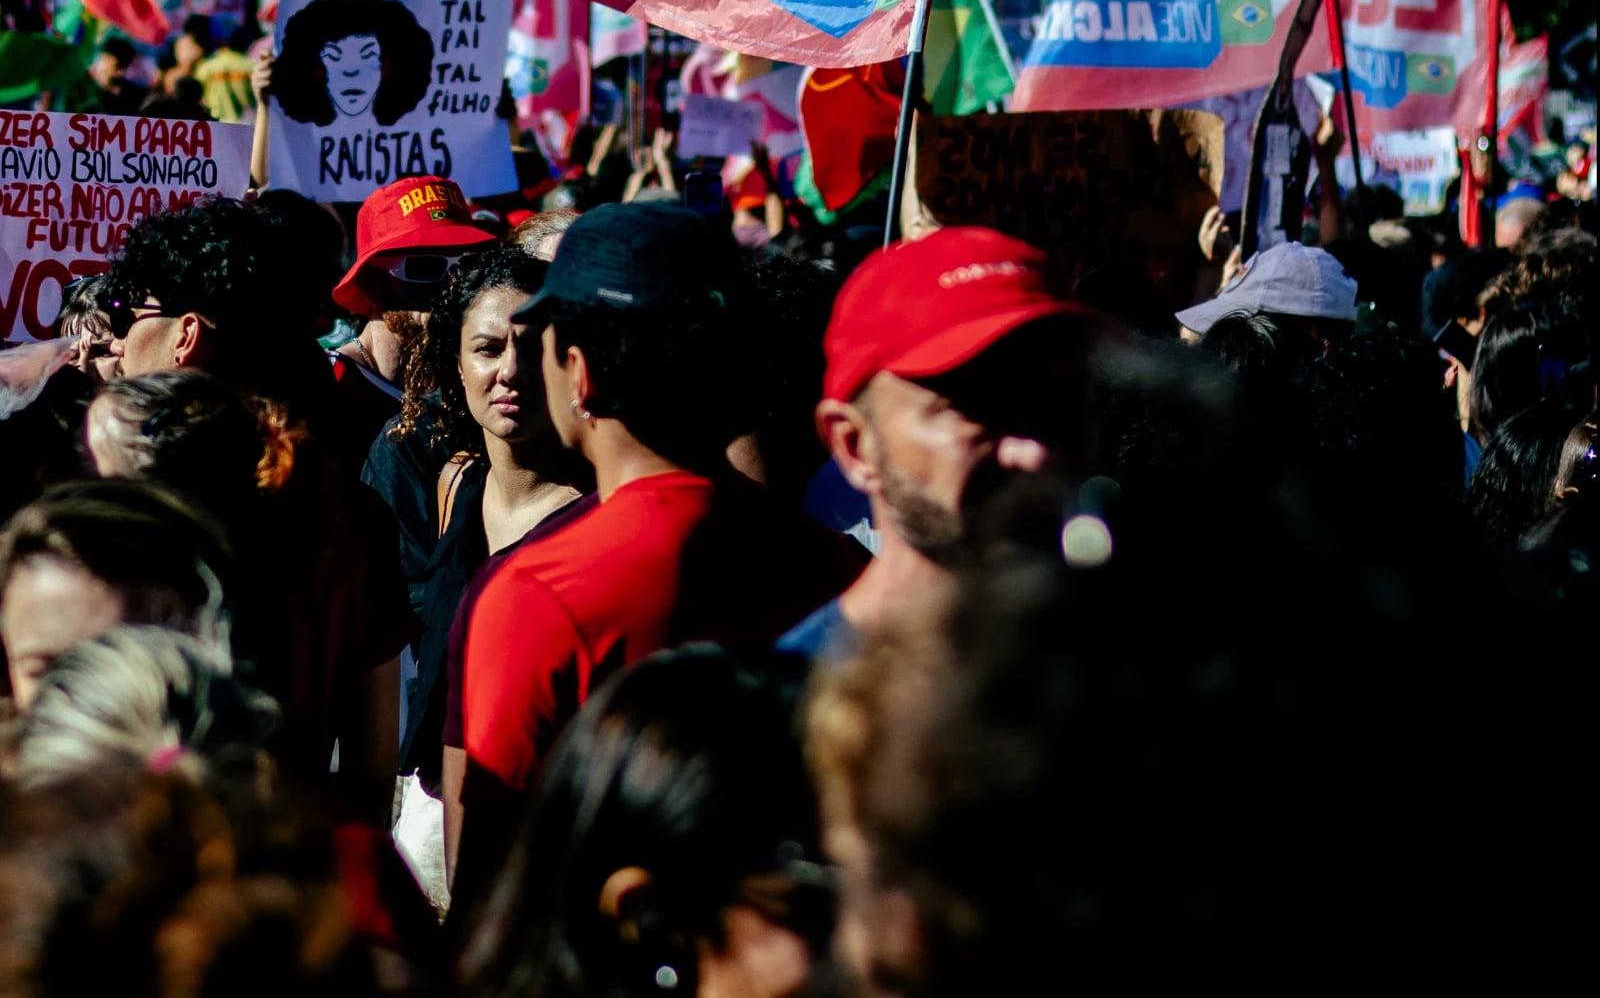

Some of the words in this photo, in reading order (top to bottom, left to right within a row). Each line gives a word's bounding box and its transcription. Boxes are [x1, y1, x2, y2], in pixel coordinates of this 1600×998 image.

[441, 0, 486, 24] TAL
[436, 63, 482, 84] TAL
[134, 119, 212, 157] PARA
[71, 149, 218, 189] BOLSONARO
[71, 182, 124, 223] NÃO
